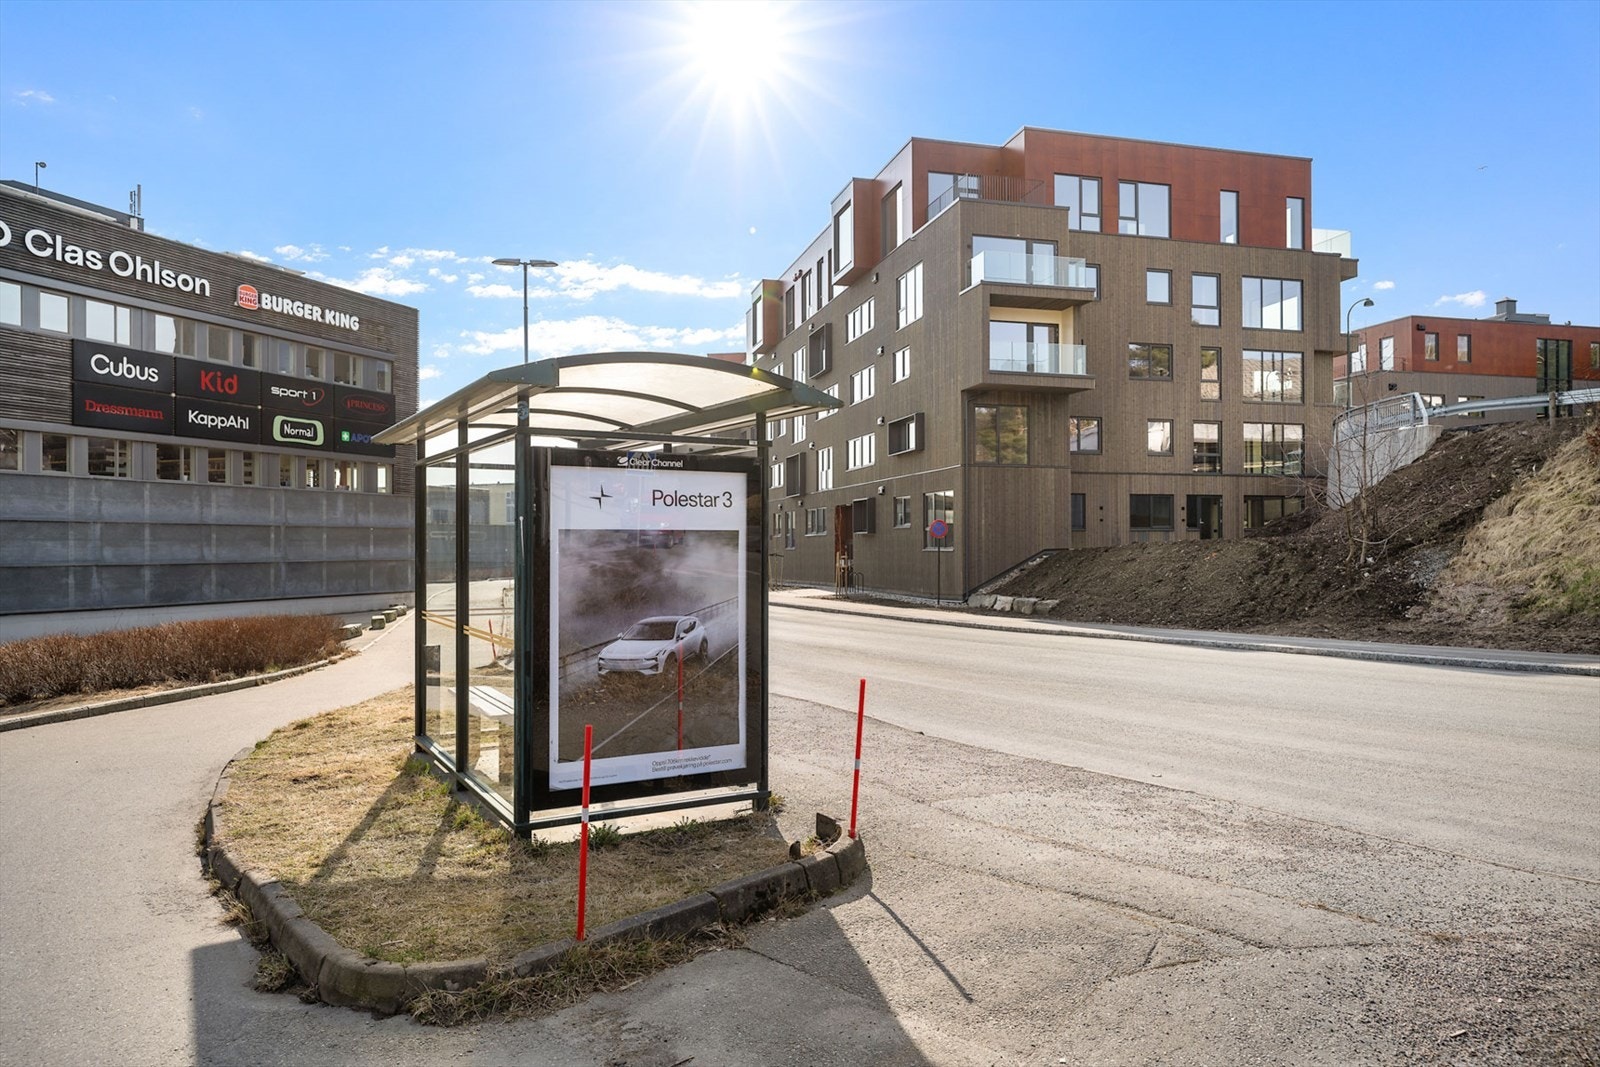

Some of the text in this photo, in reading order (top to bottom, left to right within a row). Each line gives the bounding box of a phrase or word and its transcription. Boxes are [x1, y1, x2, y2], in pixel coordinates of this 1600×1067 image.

[24, 229, 103, 270] Clas
[109, 251, 210, 297] Ohlson
[240, 296, 257, 306] KING
[261, 293, 360, 331] BURGER KING
[90, 353, 159, 383] Cubus
[200, 370, 239, 395] Kid
[270, 386, 308, 399] sport
[85, 400, 164, 420] Dressmann
[188, 409, 249, 430] KappAhl
[283, 423, 314, 438] Normal
[350, 432, 371, 444] APO
[629, 457, 684, 468] Clear Channel
[652, 489, 733, 508] Polestar 3
